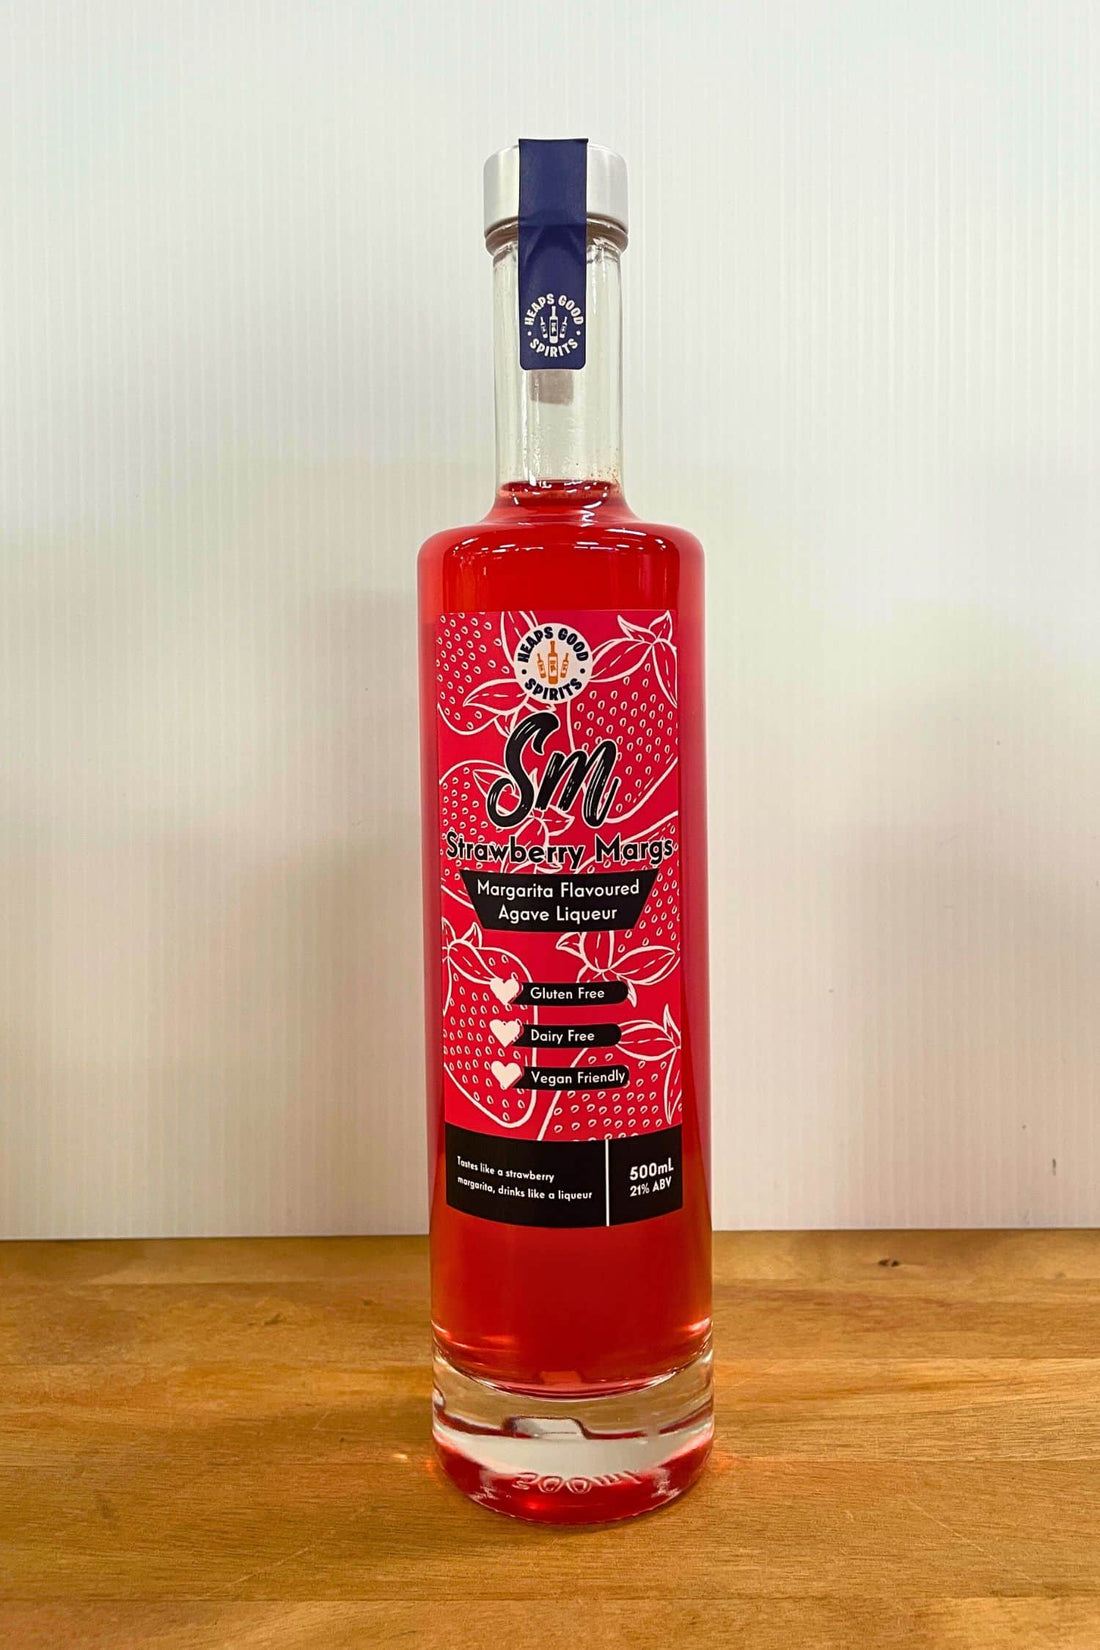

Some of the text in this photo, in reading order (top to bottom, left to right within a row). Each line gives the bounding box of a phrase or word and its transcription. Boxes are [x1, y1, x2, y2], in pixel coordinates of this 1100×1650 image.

[524, 293, 584, 326] HEAPS GOOD
[529, 338, 578, 358] SPIRITS
[517, 626, 589, 663] HEAPS GOOD
[524, 678, 582, 700] SPIRITS
[487, 711, 620, 828] Sm
[446, 831, 673, 869] Strawberry Margs
[477, 879, 640, 900] Margarita Flavoured
[498, 904, 618, 924] Agave Liqueur
[530, 987, 605, 999] Gluten Free
[531, 1029, 595, 1044] Dairy Free
[531, 1069, 626, 1086] Vegan Friendly
[457, 1155, 479, 1171] Tastes
[480, 1163, 495, 1175] like
[505, 1170, 555, 1183] strawberry
[629, 1157, 674, 1181] 500mL
[457, 1175, 496, 1194] margarita,
[498, 1184, 525, 1198] drinks
[527, 1188, 545, 1199] like
[558, 1190, 592, 1202] liqueur
[629, 1176, 672, 1197] 21% ABV
